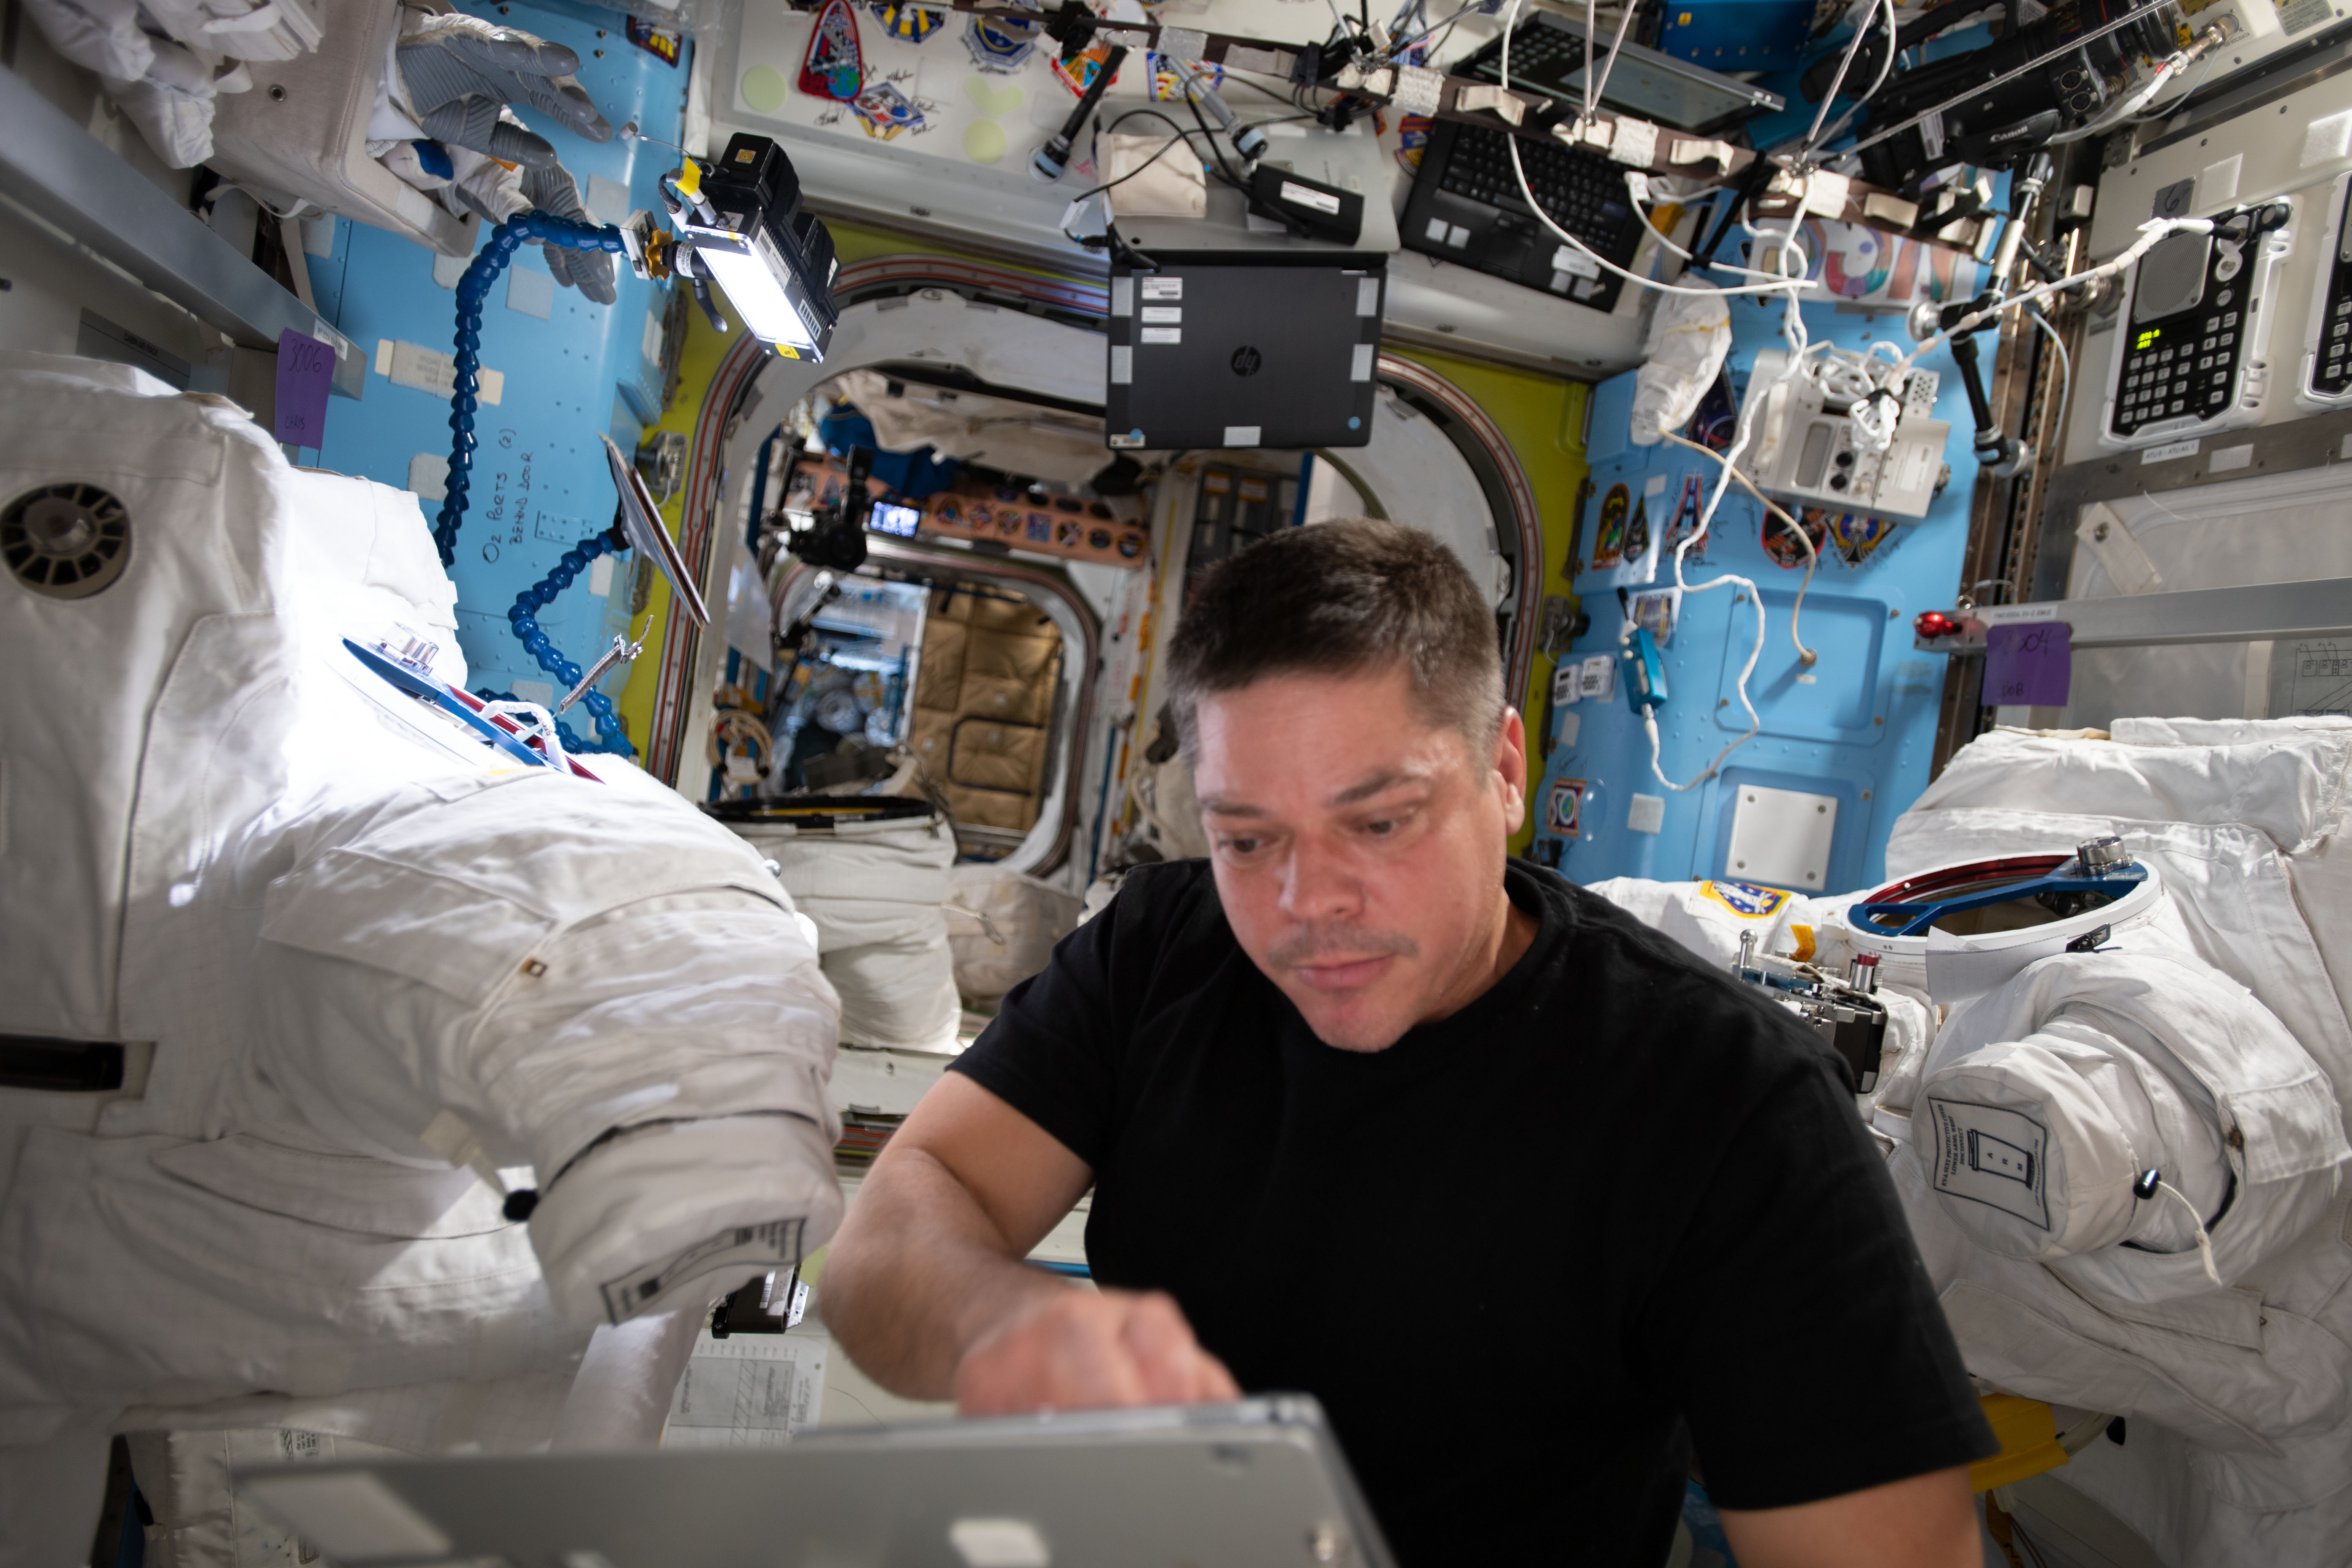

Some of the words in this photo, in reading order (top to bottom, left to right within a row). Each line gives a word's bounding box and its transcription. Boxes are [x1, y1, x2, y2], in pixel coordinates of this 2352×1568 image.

[2230, 32, 2251, 44] VDC/DATA
[1990, 125, 2028, 142] Canon
[124, 332, 138, 346] CABIN
[138, 340, 146, 351] AIR
[146, 344, 158, 357] RACK
[288, 338, 322, 373] 3006
[285, 415, 305, 430] CHRIS
[517, 452, 534, 492] DOOR
[486, 472, 507, 521] PORTS
[509, 496, 528, 545] BEHIND
[1938, 1104, 1948, 1121] COVER
[1948, 1115, 1957, 1133] WRIST
[2017, 1162, 2023, 1171] M
